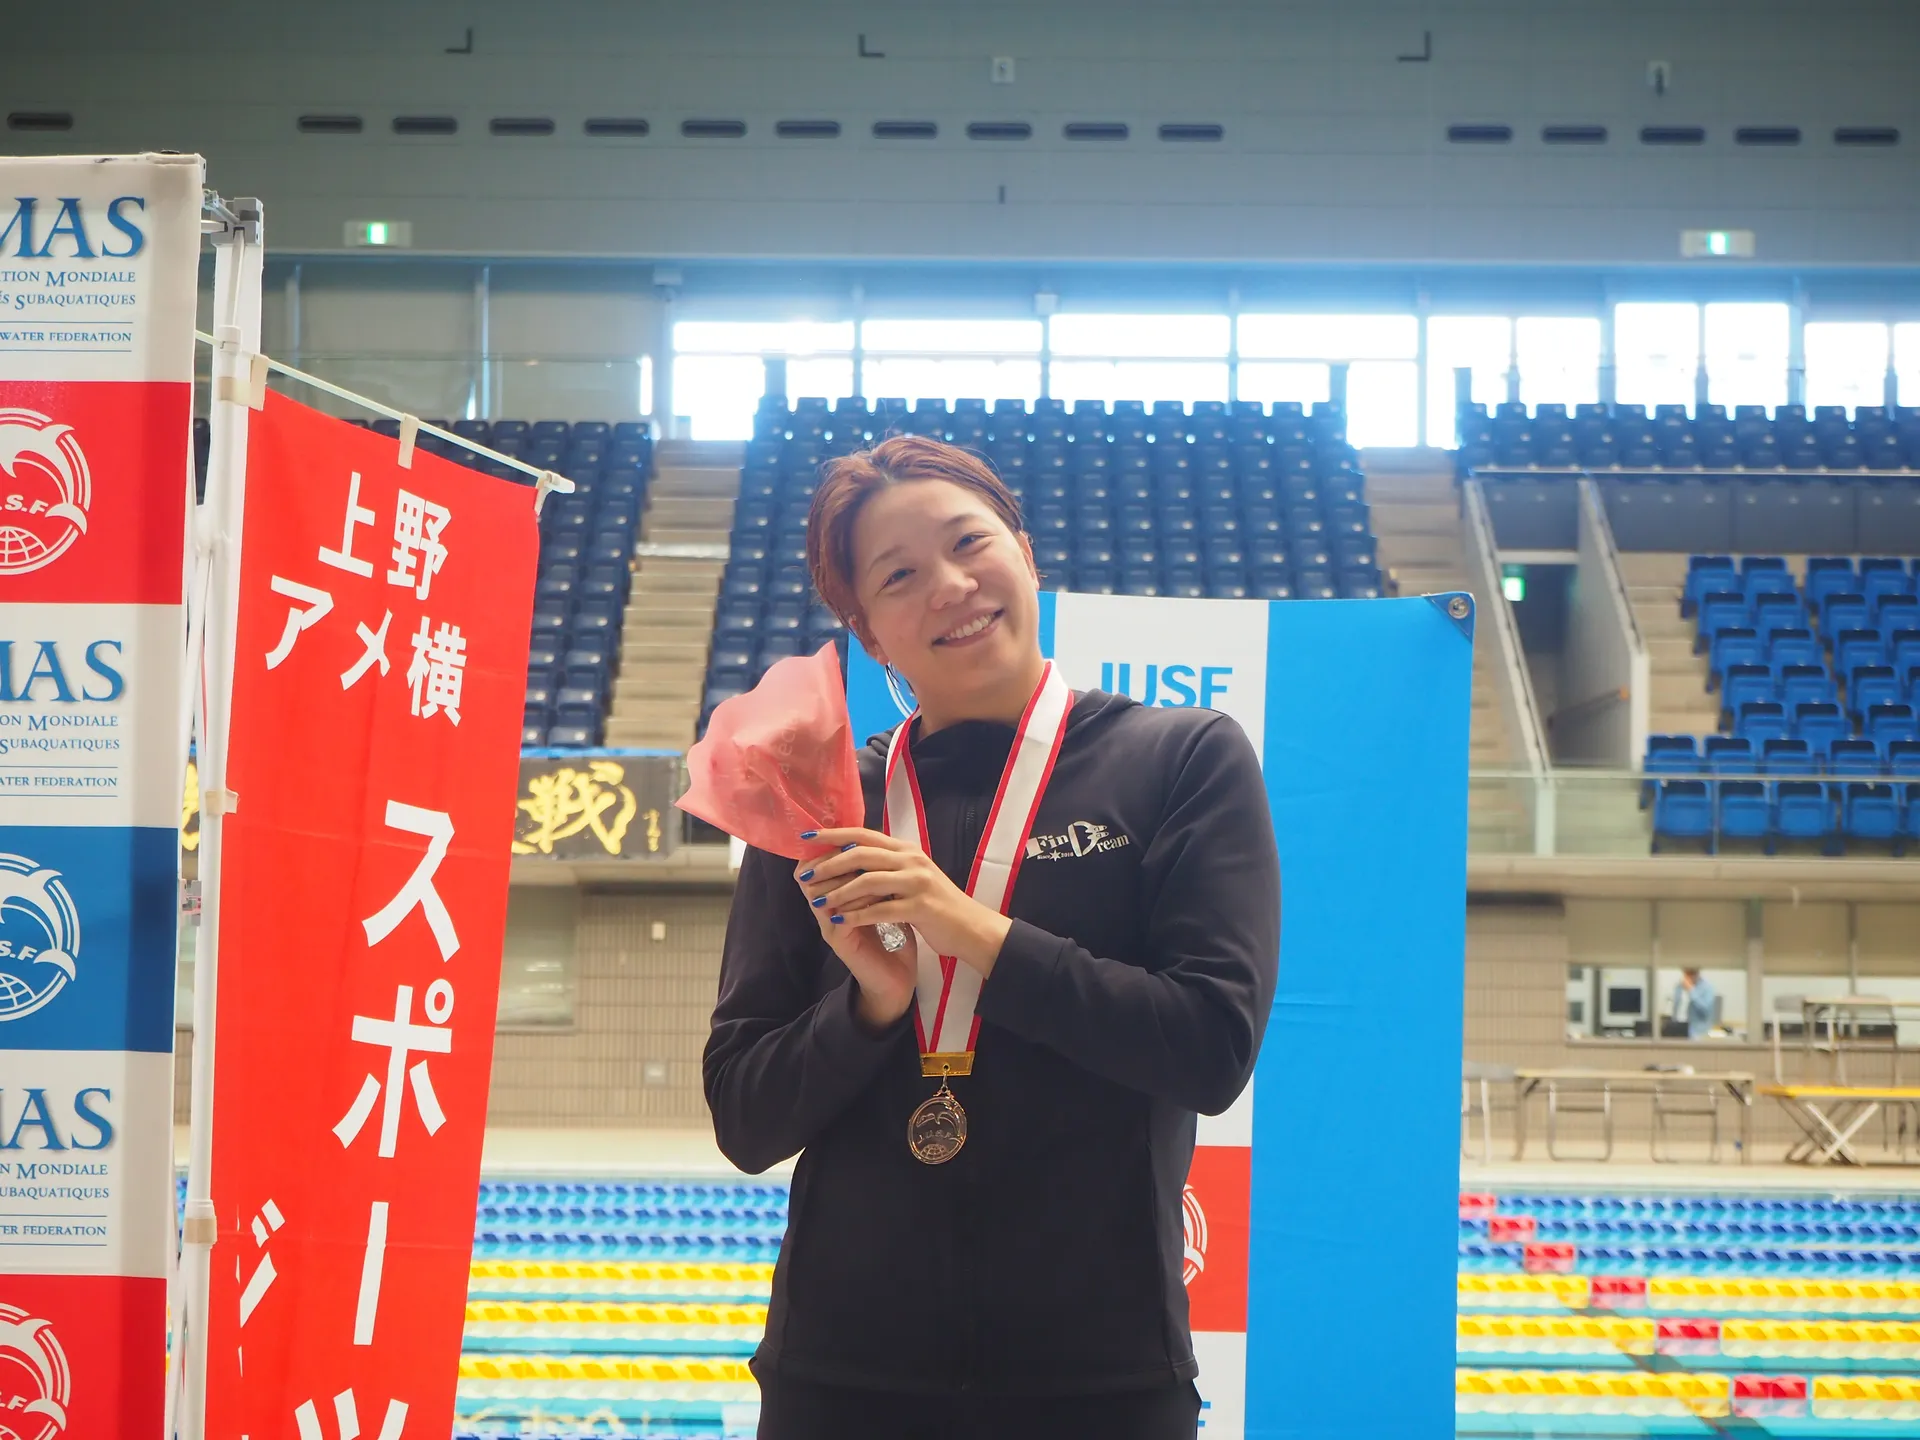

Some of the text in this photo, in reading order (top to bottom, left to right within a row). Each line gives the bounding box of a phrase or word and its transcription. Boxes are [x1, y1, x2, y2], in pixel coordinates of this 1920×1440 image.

[0, 271, 40, 282] TION
[50, 332, 132, 343] FEDERATION
[318, 471, 451, 601] 上野
[265, 574, 467, 728] アメ横
[34, 777, 118, 787] FEDERATION
[1025, 820, 1130, 859] Fin Dream
[0, 1087, 113, 1150] AS
[23, 1225, 107, 1236] FEDERATION
